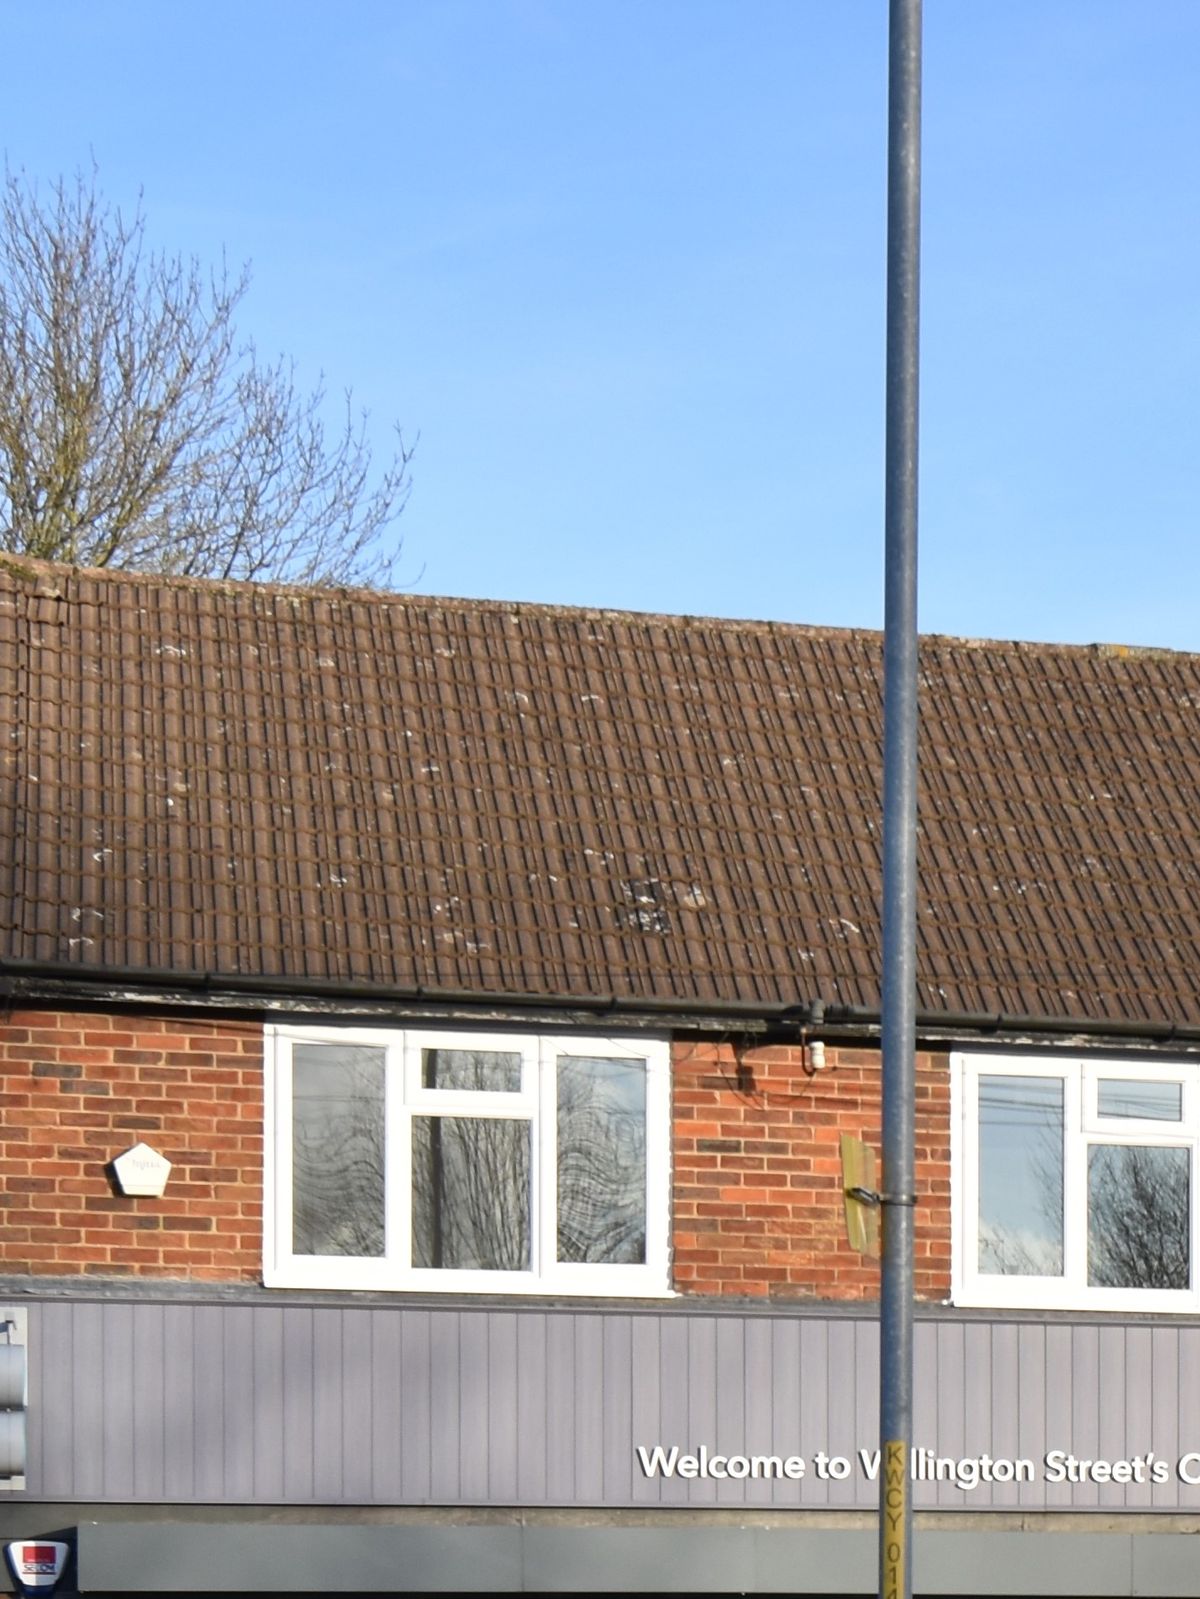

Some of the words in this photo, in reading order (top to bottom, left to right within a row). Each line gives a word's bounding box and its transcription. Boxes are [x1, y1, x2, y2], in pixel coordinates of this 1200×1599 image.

[637, 1445, 806, 1479] Welcome
[813, 1450, 851, 1479] to
[859, 1447, 1034, 1490] Wllington
[885, 1445, 905, 1532] KWCY
